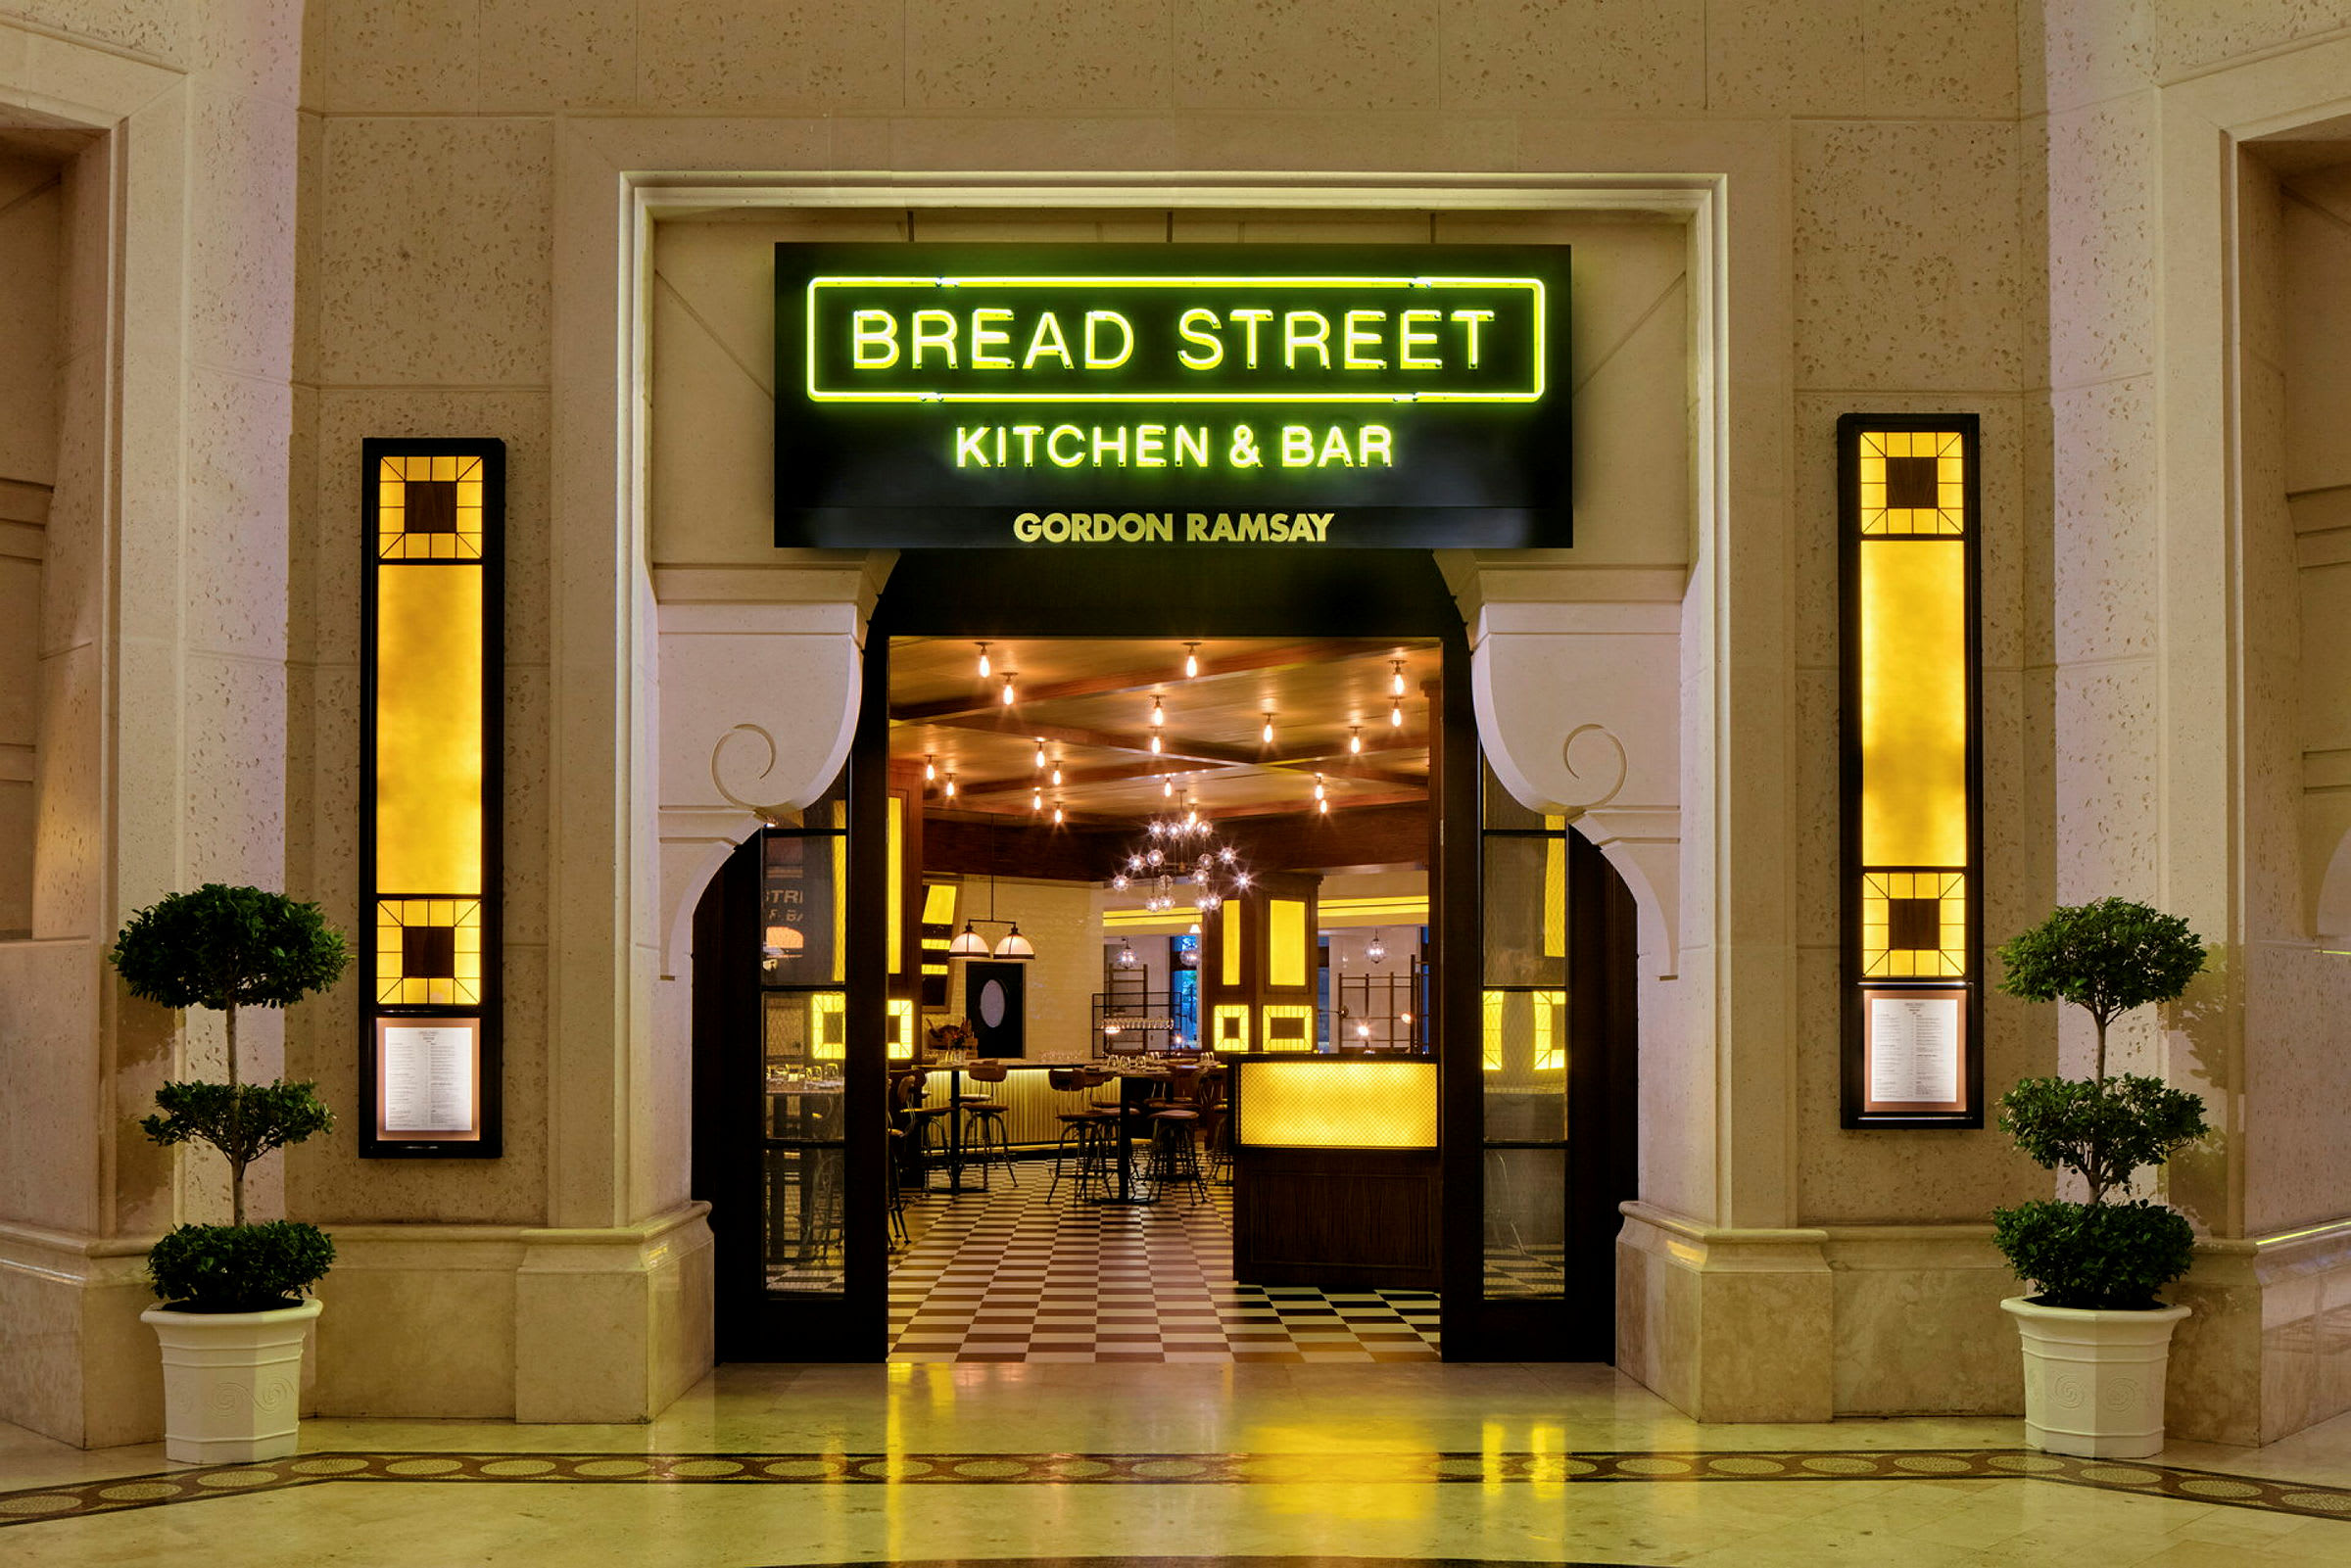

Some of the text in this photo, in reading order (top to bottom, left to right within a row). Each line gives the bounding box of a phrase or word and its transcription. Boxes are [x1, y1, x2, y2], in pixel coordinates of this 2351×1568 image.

[852, 308, 1496, 370] BREAD STREET
[955, 423, 1393, 469] KITCHEN & BAR
[1013, 512, 1335, 544] GORDON RAMSAY
